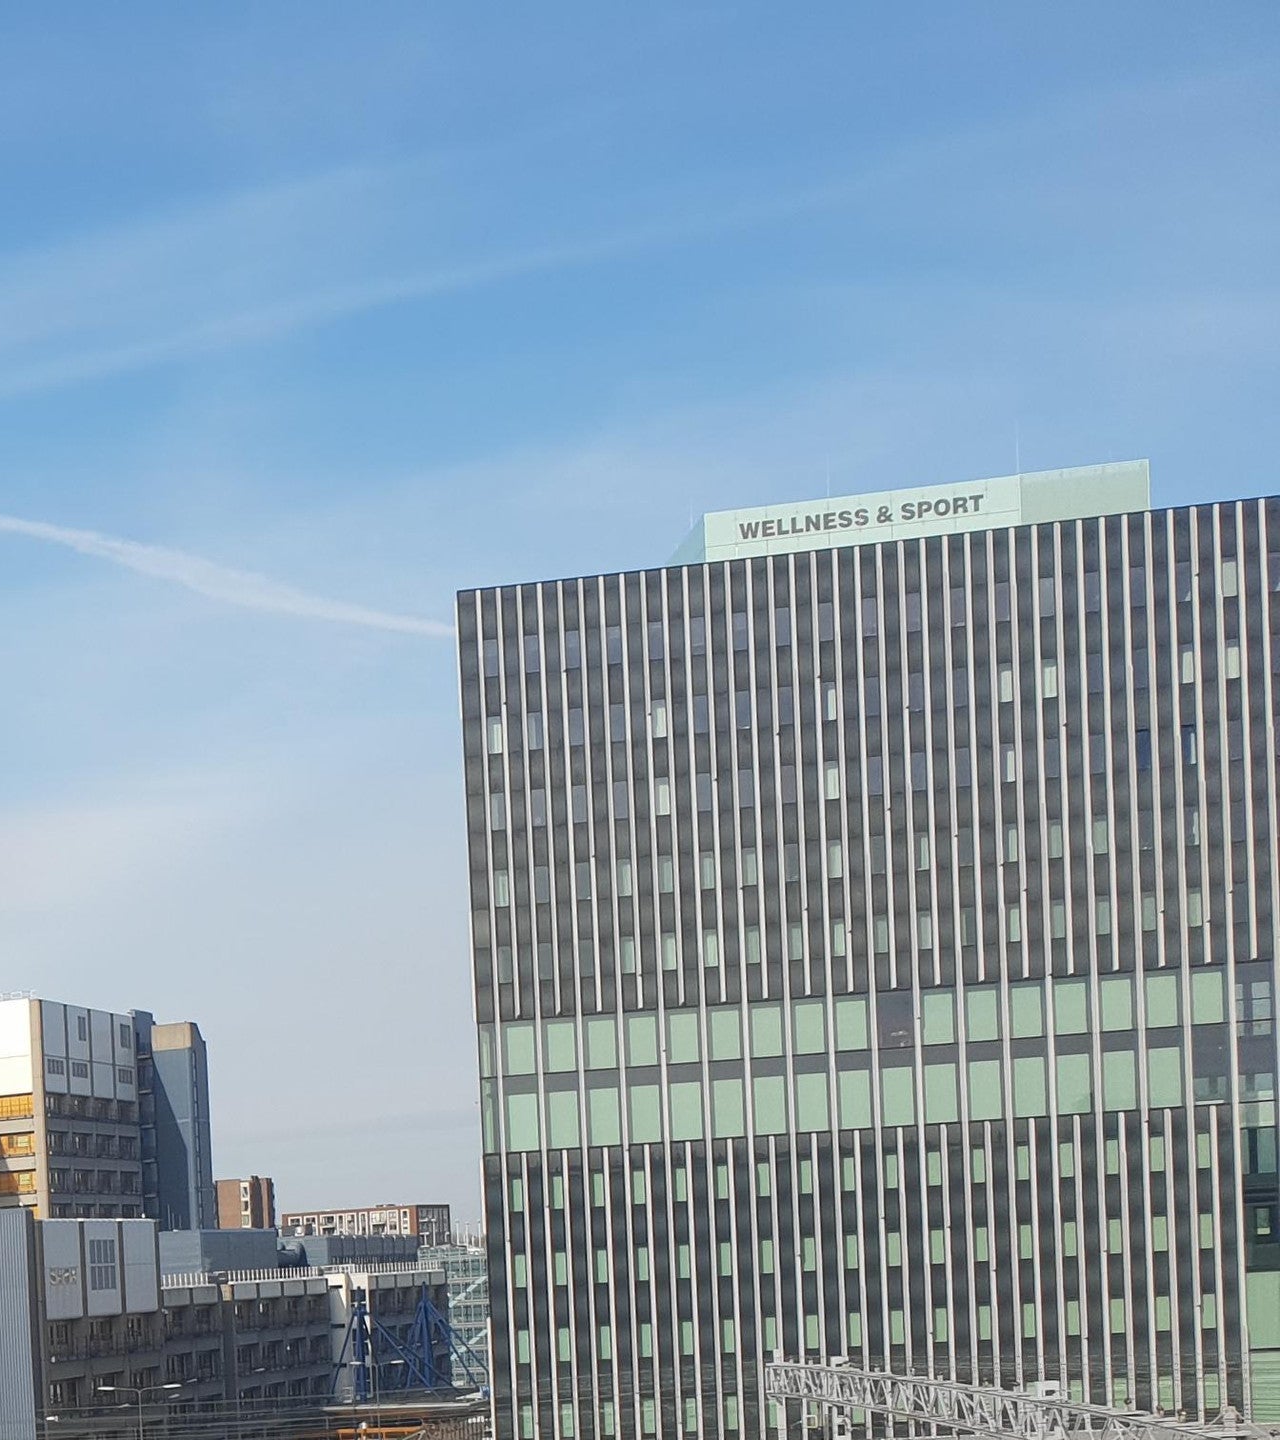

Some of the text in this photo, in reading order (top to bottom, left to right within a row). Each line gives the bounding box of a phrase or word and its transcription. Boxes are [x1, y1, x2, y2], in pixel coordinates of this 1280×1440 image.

[739, 494, 984, 540] WELLNESS & SPORT
